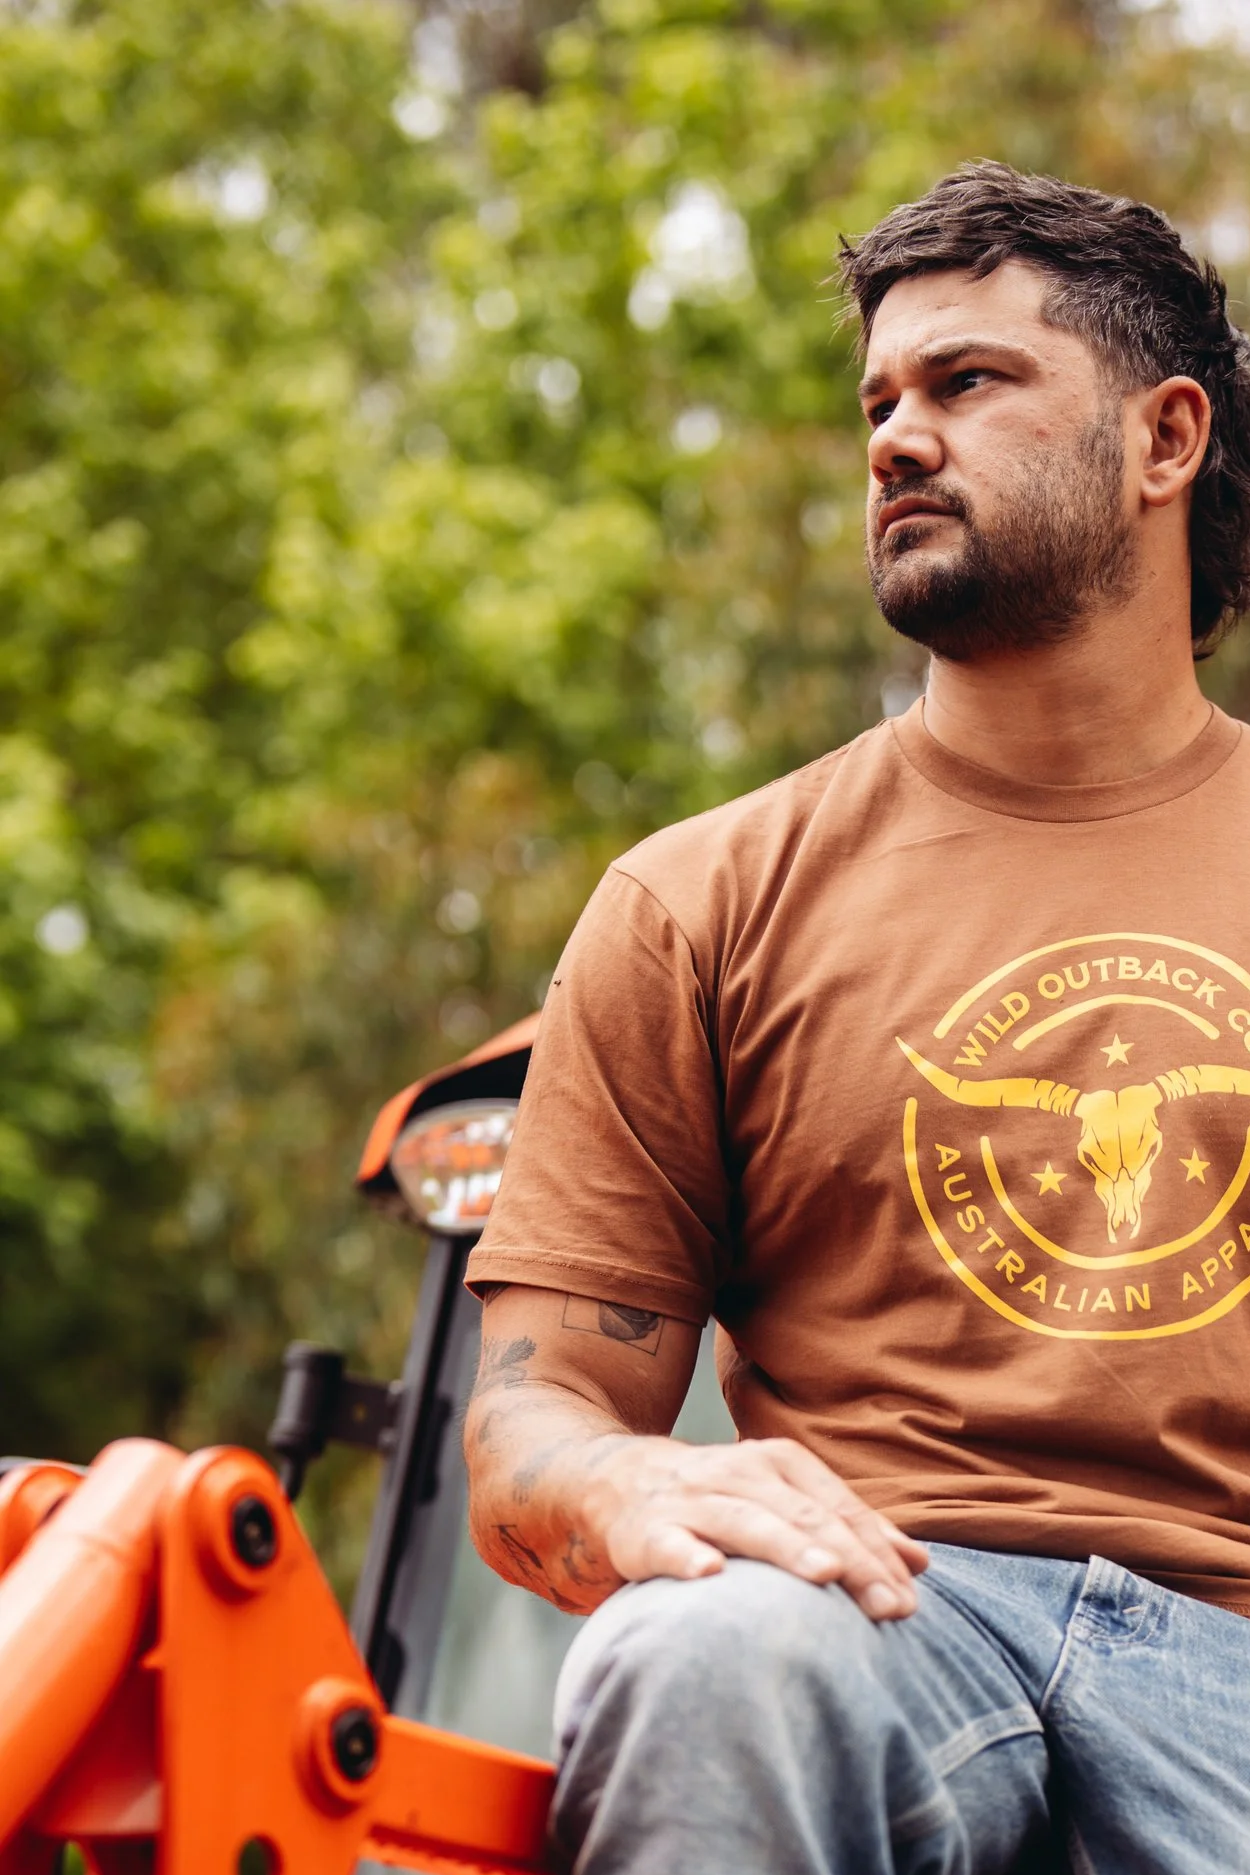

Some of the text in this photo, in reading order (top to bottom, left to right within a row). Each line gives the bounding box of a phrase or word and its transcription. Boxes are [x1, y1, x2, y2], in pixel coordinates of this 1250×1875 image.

[953, 990, 1031, 1068] WILD
[1037, 956, 1227, 1009] OUTBACK
[934, 1142, 1152, 1313] AUSTRALIAN
